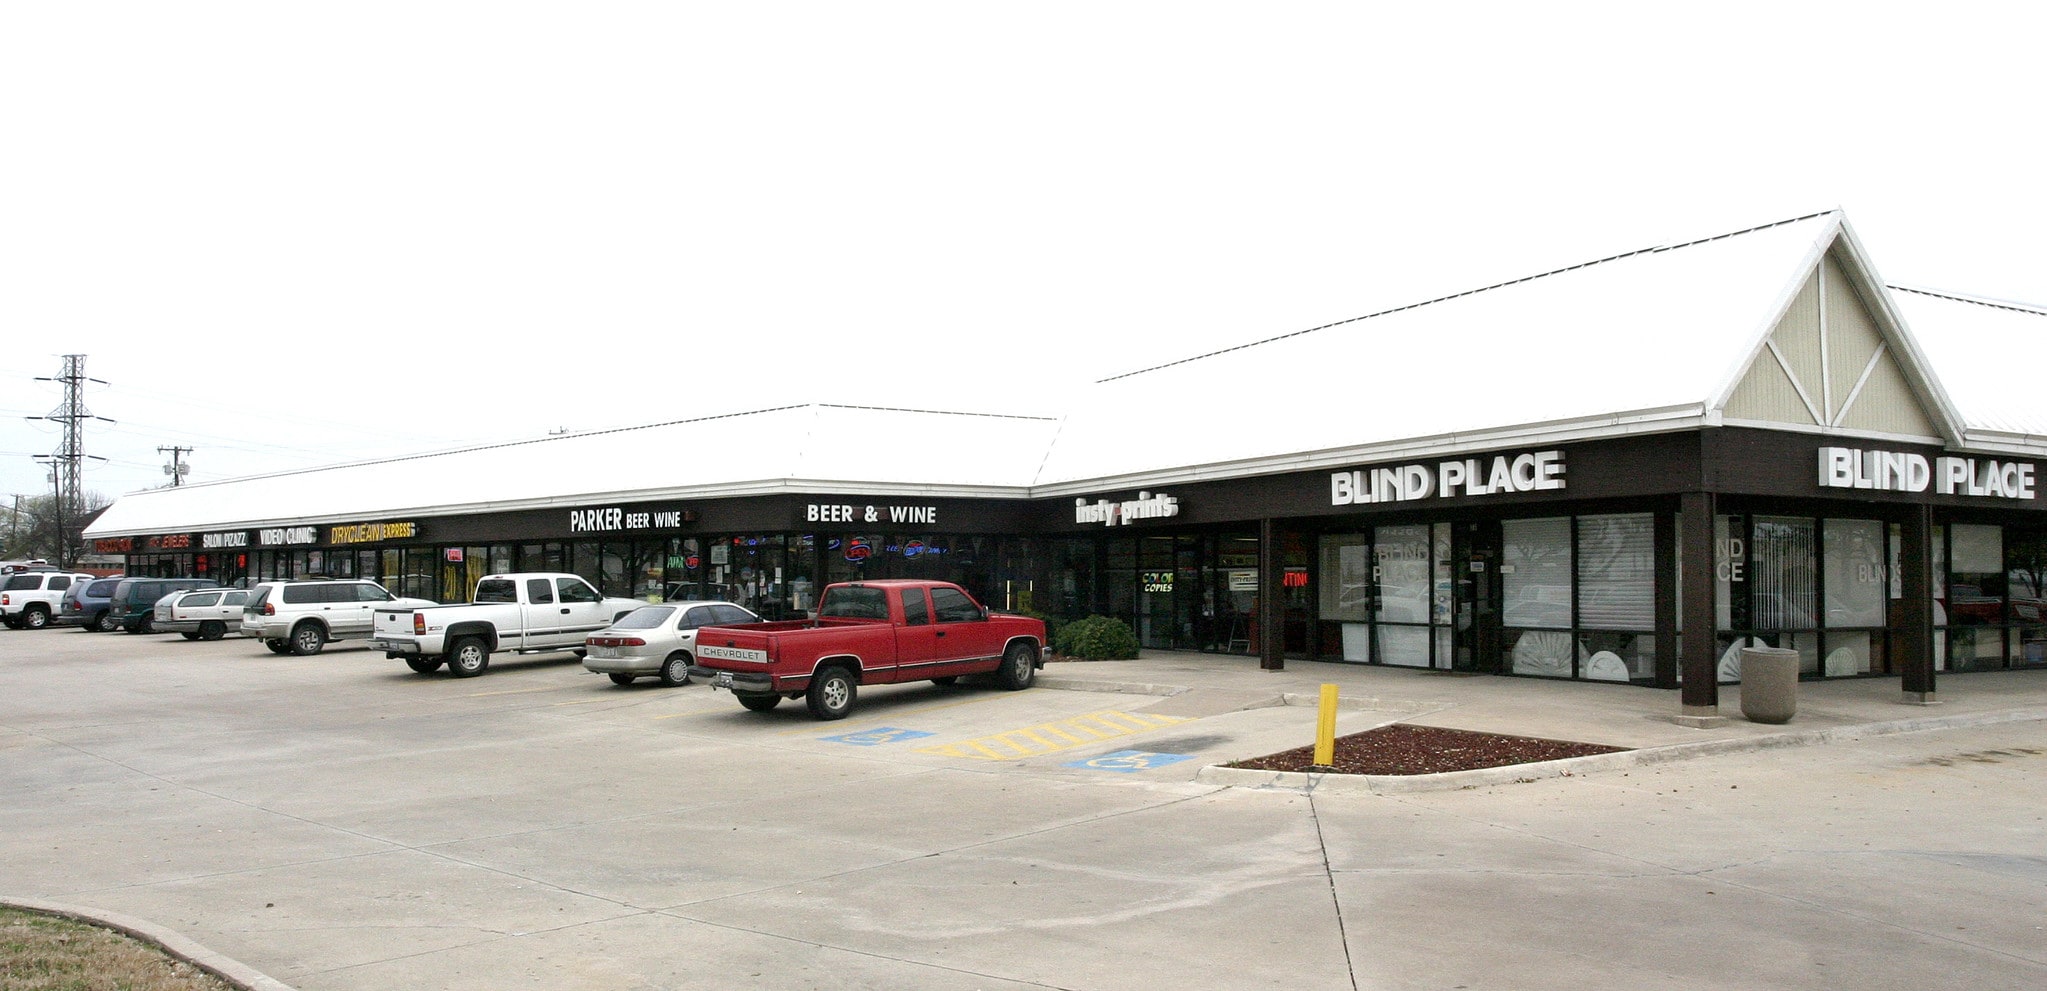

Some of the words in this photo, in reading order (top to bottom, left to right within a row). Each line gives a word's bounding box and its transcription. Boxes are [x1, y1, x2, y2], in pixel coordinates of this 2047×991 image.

[1331, 464, 1435, 505] BLIND
[1439, 450, 1566, 498] PLACE
[1819, 447, 1930, 493] BLIND
[1936, 456, 2035, 499] PLACE
[570, 508, 622, 532] PARKER
[626, 513, 650, 529] BEER
[654, 511, 681, 528] WINE
[807, 504, 853, 523] BEER
[864, 505, 878, 522] &
[890, 506, 937, 524] WINE
[259, 529, 285, 545] VIDEO
[286, 527, 316, 544] CLINIC
[383, 522, 413, 538] EXPRESS
[203, 533, 222, 548] SALON
[223, 532, 246, 548] PIZAZZ
[1144, 583, 1173, 592] COPIES
[703, 647, 760, 660] CHEVROLET
